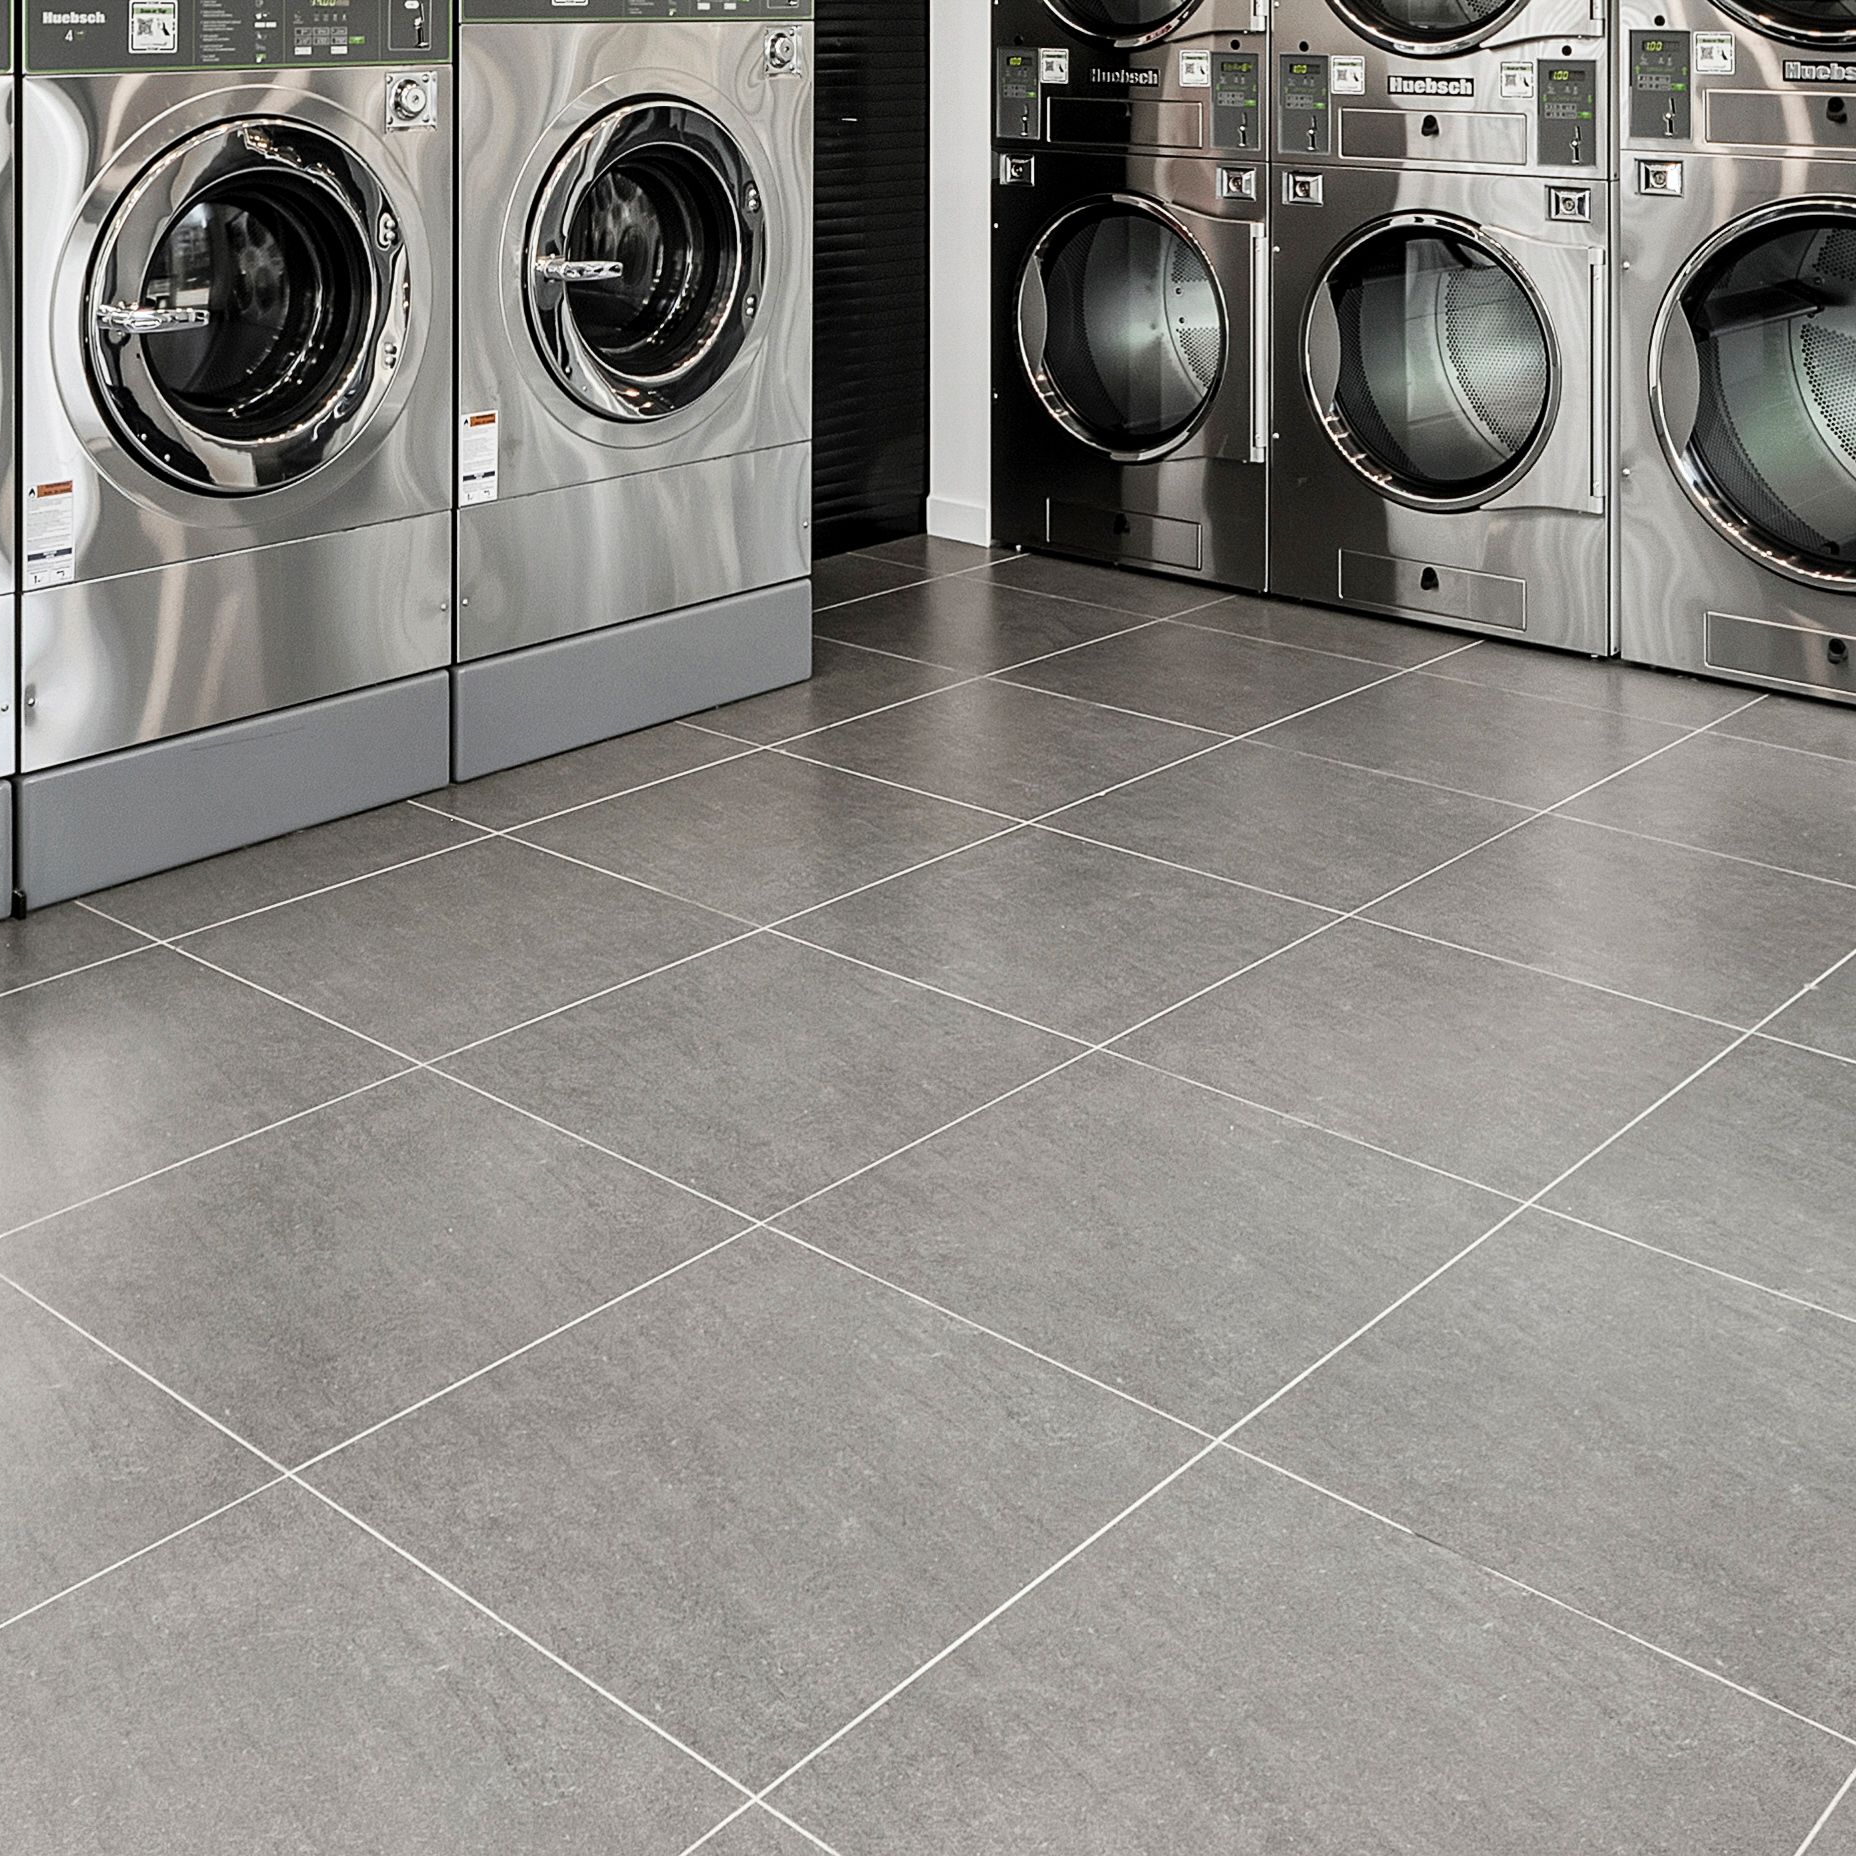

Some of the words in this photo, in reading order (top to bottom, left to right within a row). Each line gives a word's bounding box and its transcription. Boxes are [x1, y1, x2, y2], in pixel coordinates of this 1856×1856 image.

[42, 10, 106, 25] Huebsch
[64, 29, 74, 41] 4
[1389, 77, 1473, 95] Huebsch
